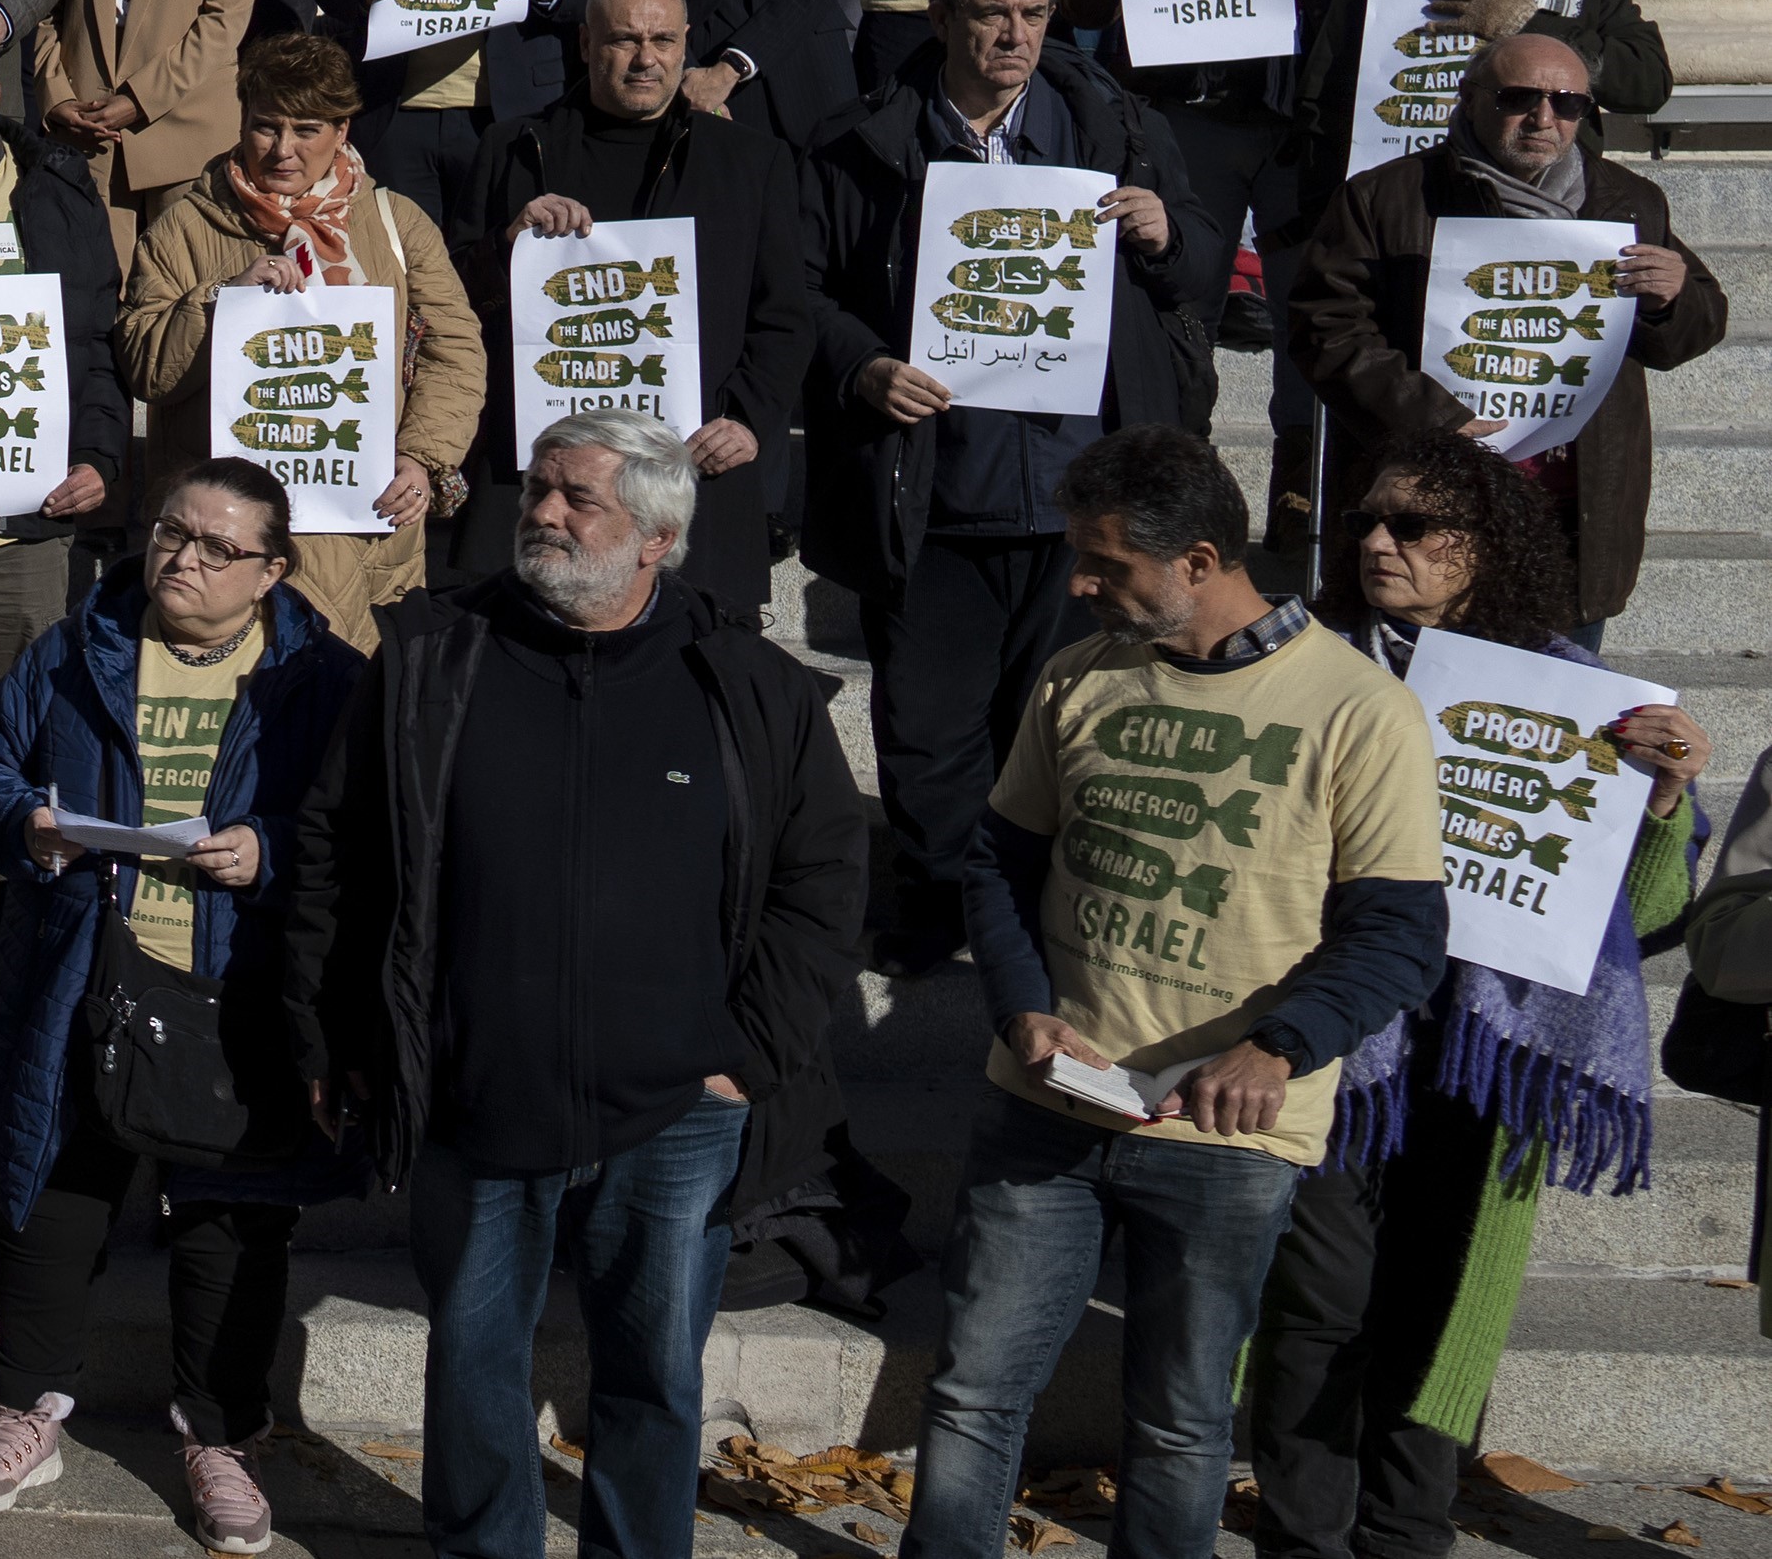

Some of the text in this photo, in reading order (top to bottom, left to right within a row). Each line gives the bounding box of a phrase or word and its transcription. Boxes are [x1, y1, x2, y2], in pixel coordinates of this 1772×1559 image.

[1382, 137, 1401, 145] WITH
[567, 267, 626, 303] END
[968, 261, 1041, 291] تجارة
[1493, 266, 1558, 295] END
[942, 300, 1030, 330] الأسلحة
[1500, 318, 1560, 338] ARMS
[581, 318, 635, 343] ARMS
[267, 330, 325, 364] END
[928, 334, 1067, 372] مع إسرائيل
[559, 360, 621, 380] TRADE
[1473, 353, 1539, 378] TRADE
[278, 382, 332, 406] ARMS
[546, 399, 565, 407] WITH
[1478, 391, 1576, 419] ISRAEL
[256, 422, 316, 444] TRADE
[197, 712, 219, 730] AL
[1119, 715, 1216, 758] FIN AL
[1438, 764, 1542, 805] COMERÇ
[1084, 786, 1199, 826] COMERCIO
[1089, 847, 1160, 887] ARMAS
